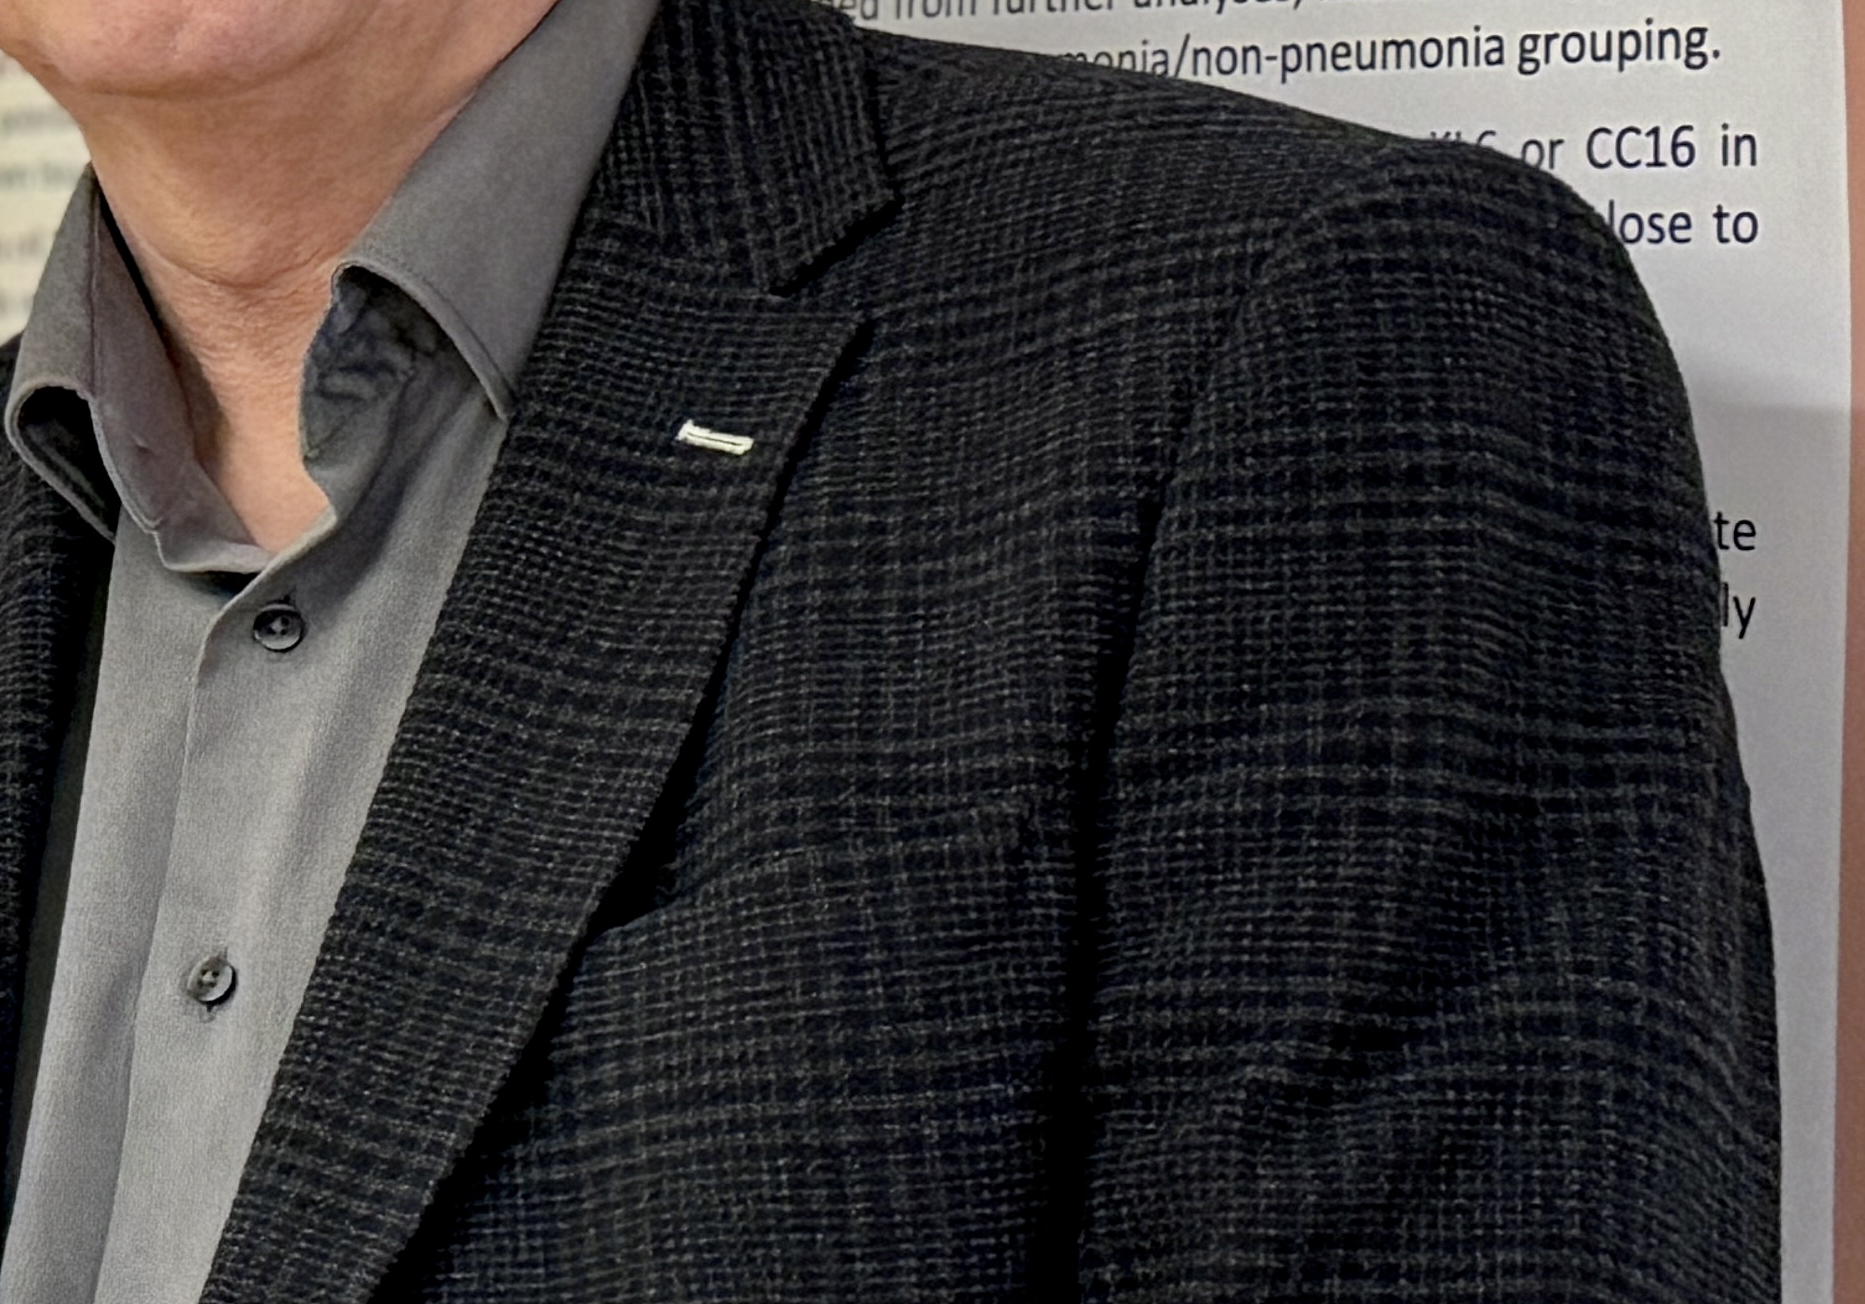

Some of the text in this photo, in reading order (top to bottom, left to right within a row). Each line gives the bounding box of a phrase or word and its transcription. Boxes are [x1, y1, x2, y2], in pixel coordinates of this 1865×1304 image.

[1517, 17, 1721, 76] grouping.
[1521, 122, 1757, 170] or CC16 in
[1608, 199, 1759, 245] lose to
